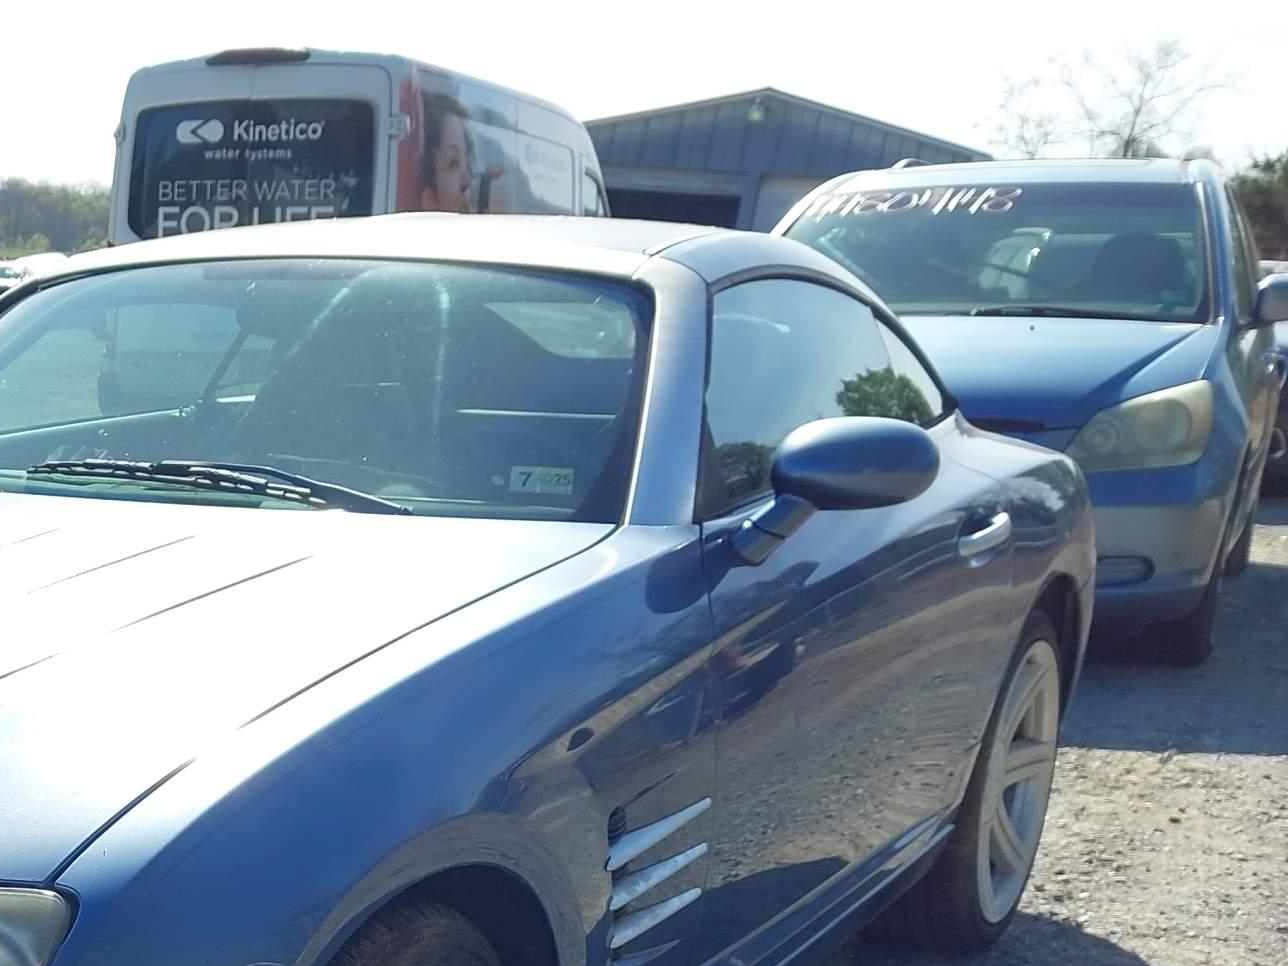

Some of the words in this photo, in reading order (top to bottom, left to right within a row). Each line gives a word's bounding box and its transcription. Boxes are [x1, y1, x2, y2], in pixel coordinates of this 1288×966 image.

[233, 118, 324, 141] Kinetico
[203, 148, 241, 160] water
[159, 180, 248, 201] BETTER
[253, 180, 336, 201] WATER
[518, 471, 533, 488] 7
